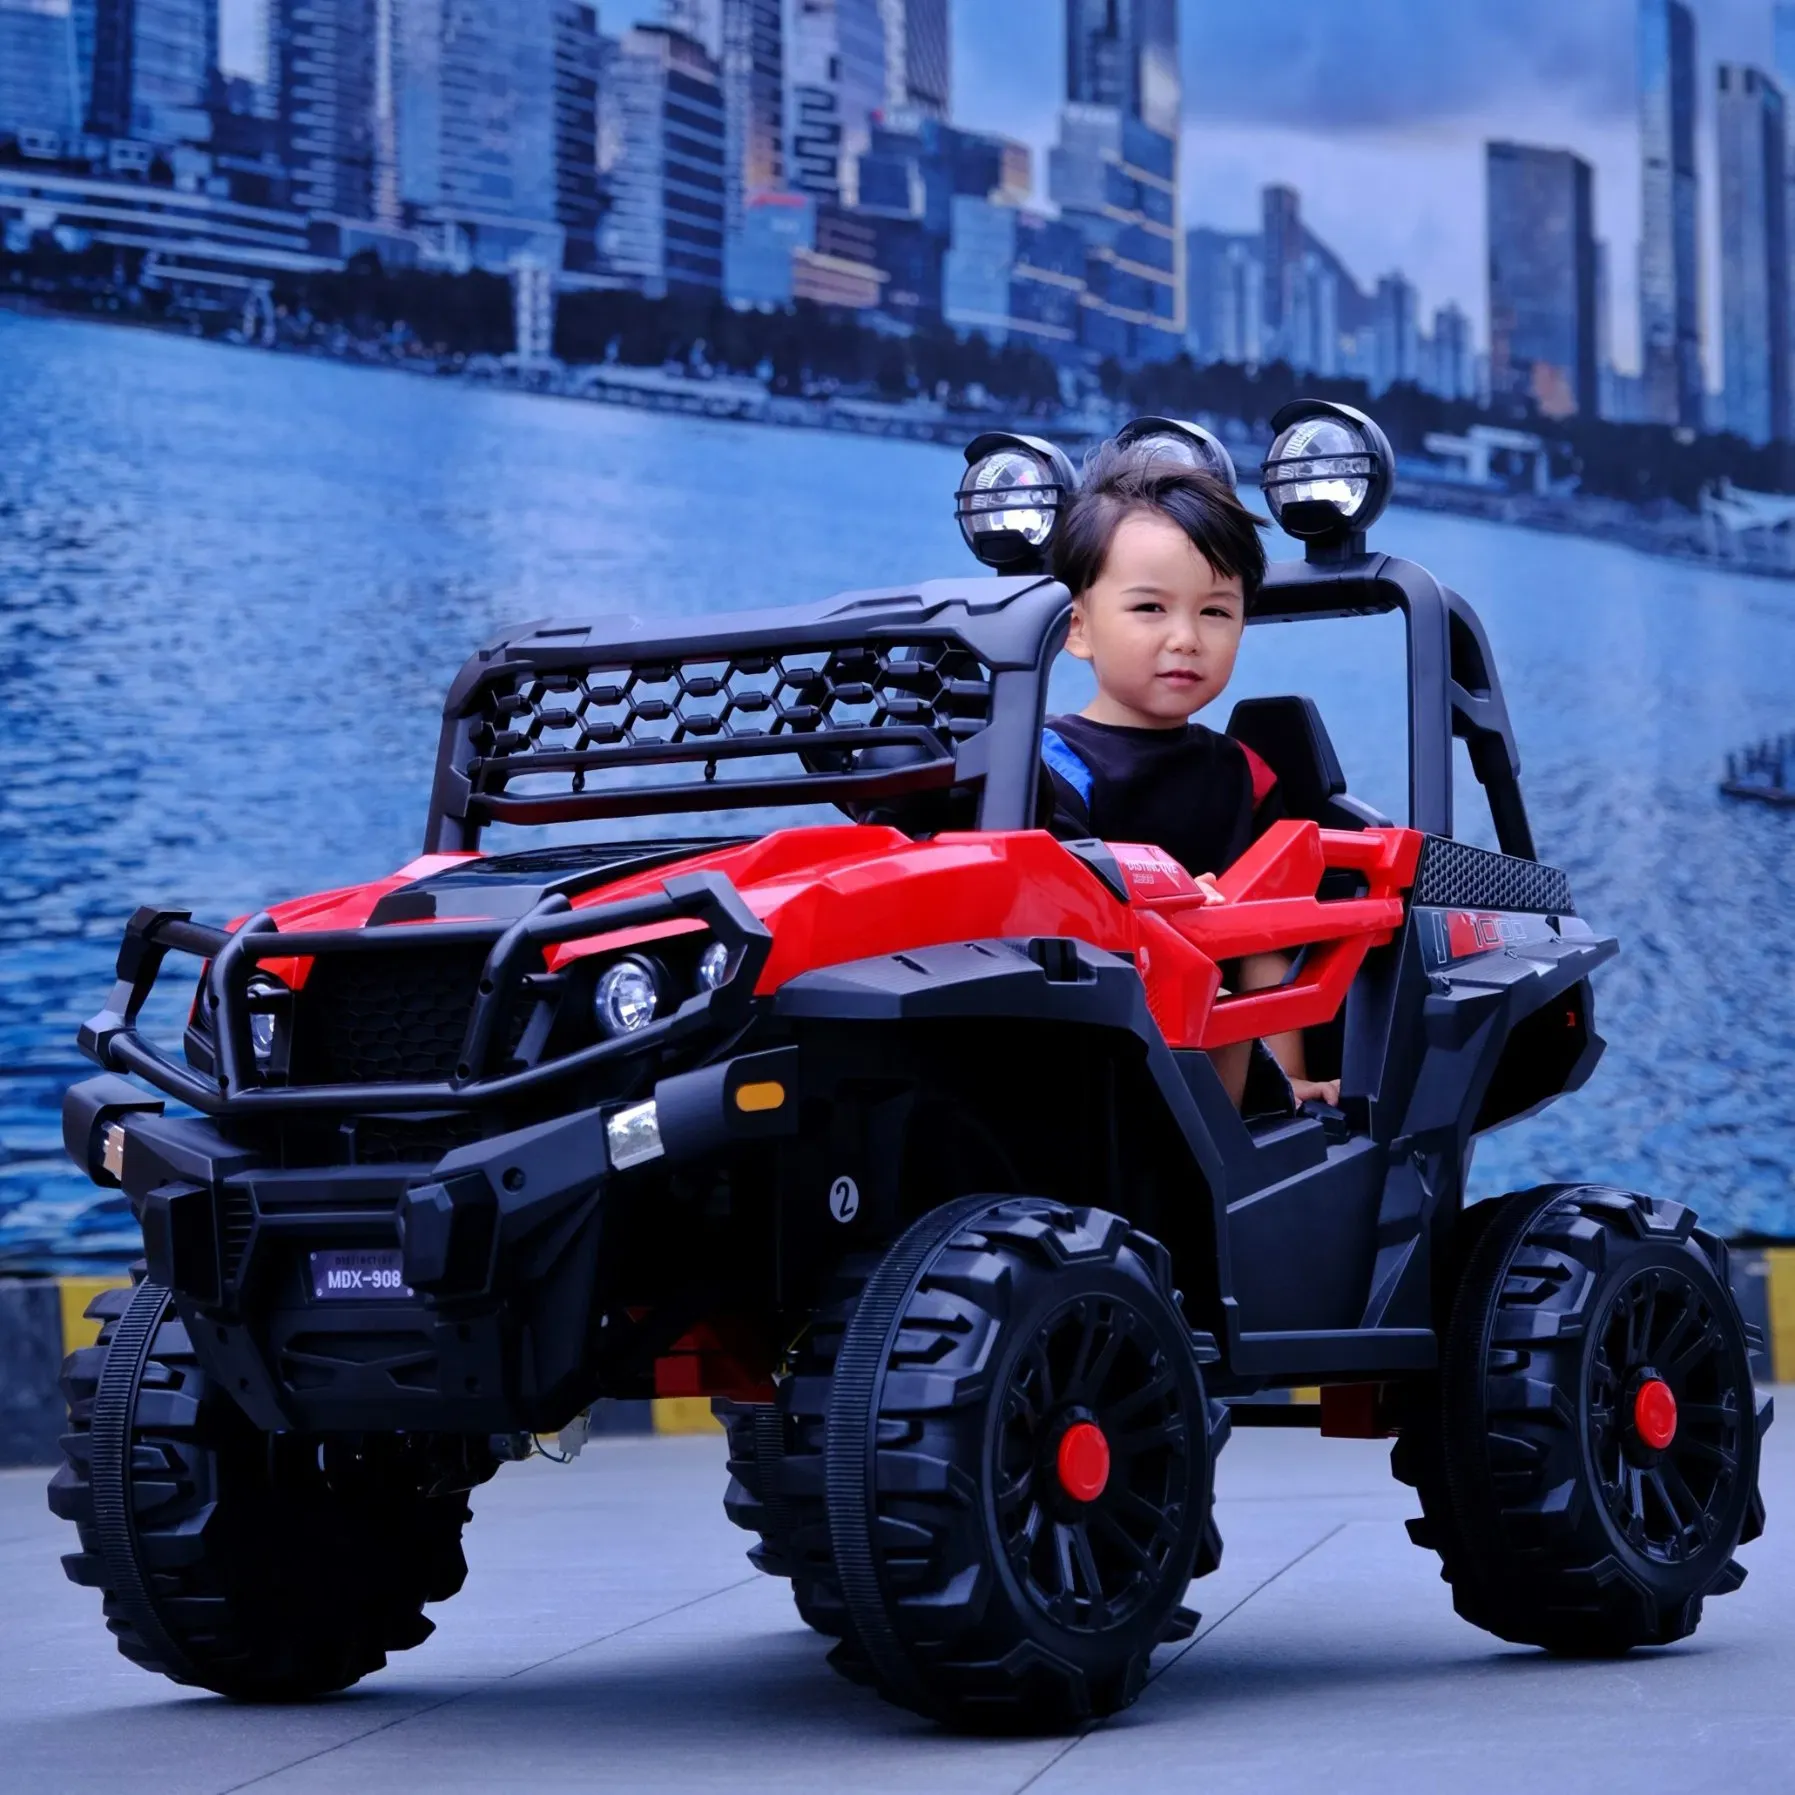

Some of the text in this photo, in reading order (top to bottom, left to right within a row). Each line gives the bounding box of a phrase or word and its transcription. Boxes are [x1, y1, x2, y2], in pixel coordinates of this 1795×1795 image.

[1462, 912, 1527, 948] 1000
[835, 1181, 854, 1218] 2
[327, 1270, 401, 1289] MDX-908
